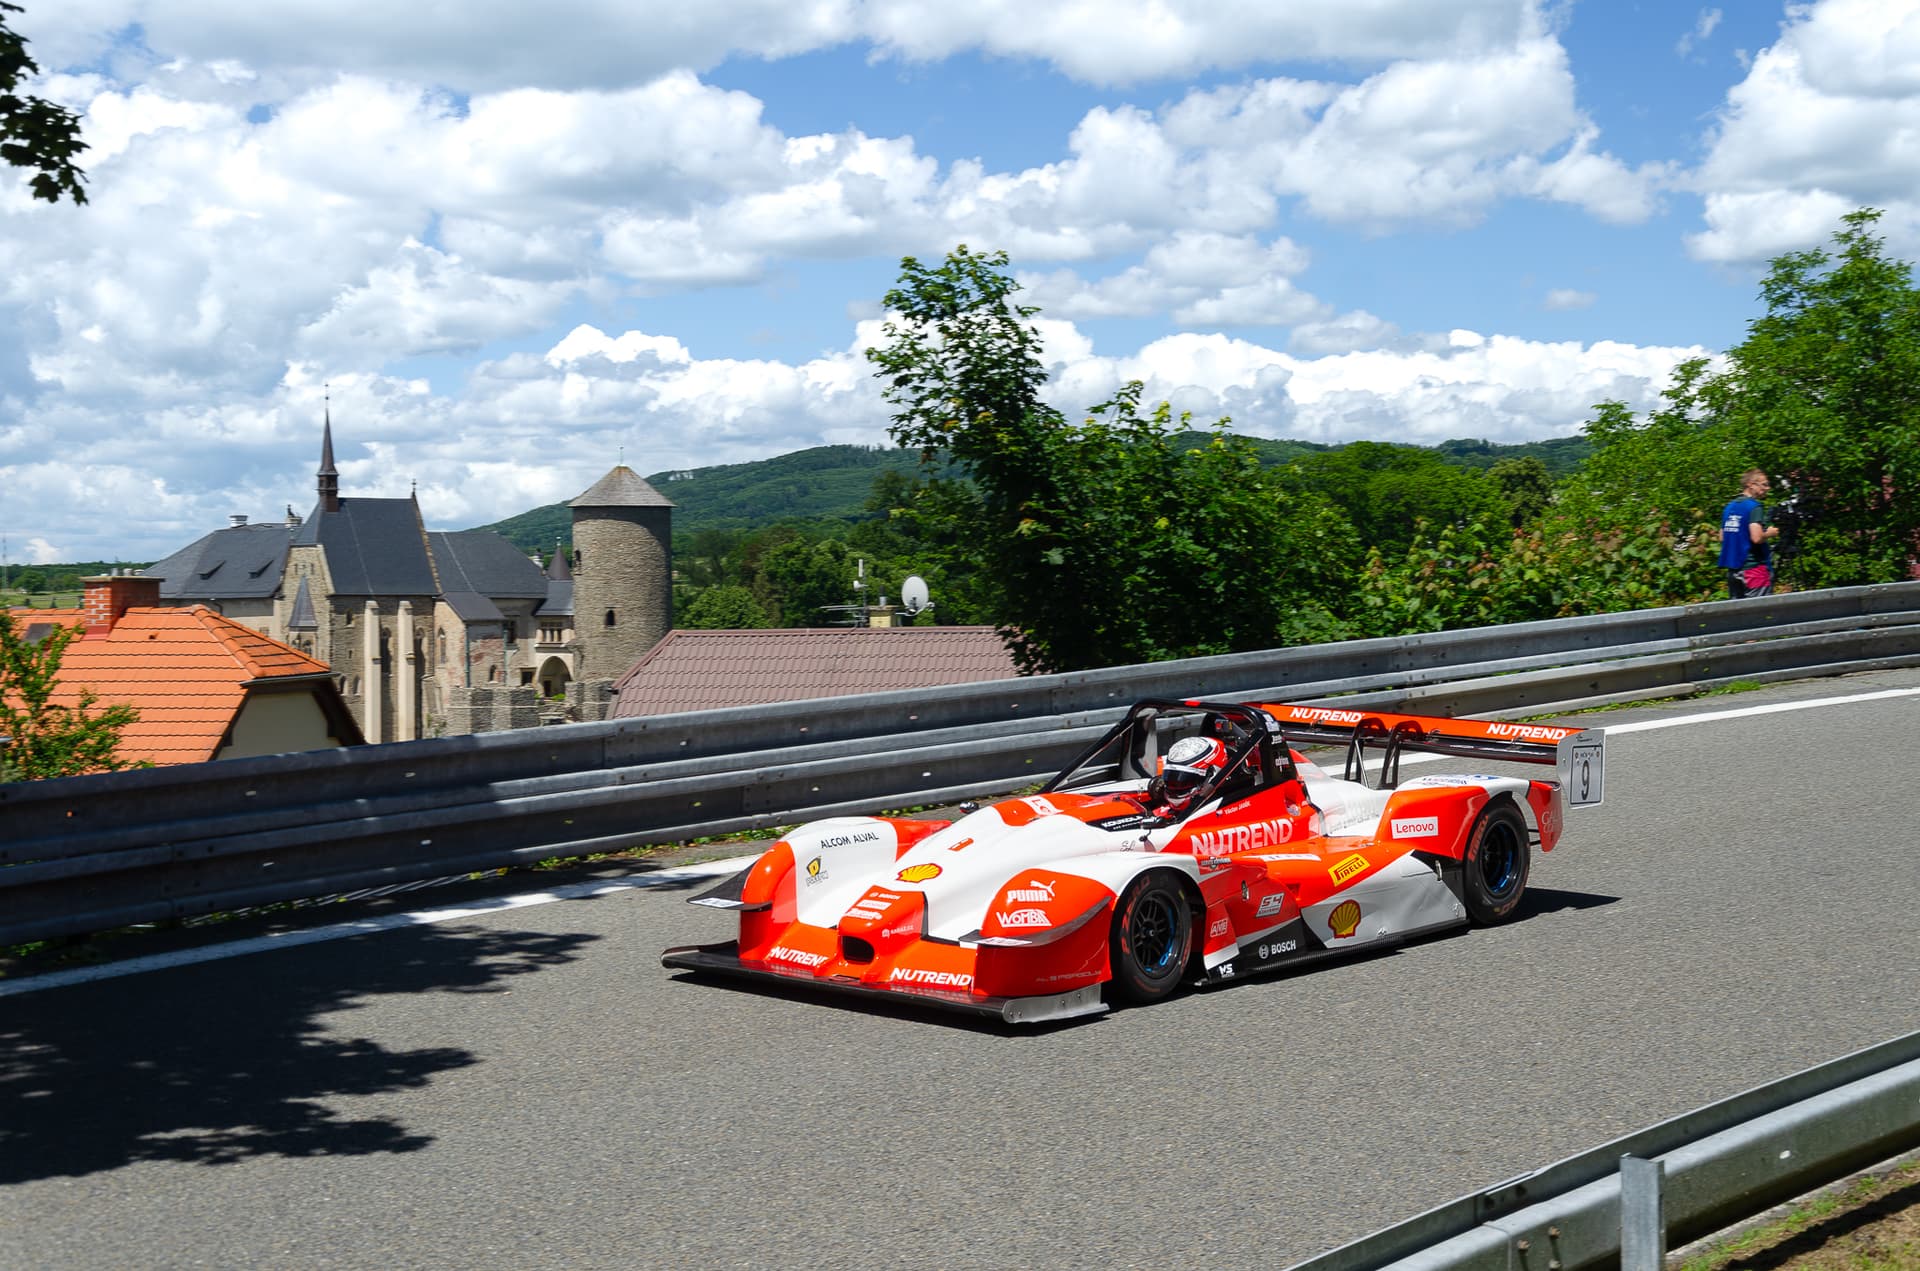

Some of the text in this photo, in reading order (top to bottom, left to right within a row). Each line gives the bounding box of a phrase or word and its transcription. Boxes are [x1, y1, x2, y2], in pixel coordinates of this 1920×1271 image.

[1290, 707, 1364, 723] NUTREND
[1486, 723, 1568, 741] NUTREND
[1581, 760, 1590, 801] 9
[1396, 822, 1434, 834] Lenovo
[820, 832, 880, 849] ALCOM ALVAL
[1190, 818, 1295, 857] NUTREND
[1333, 857, 1366, 881] PIRELLI
[1006, 889, 1051, 905] PUMA
[1271, 940, 1296, 955] BOSCH
[890, 967, 972, 986] NUTREND
